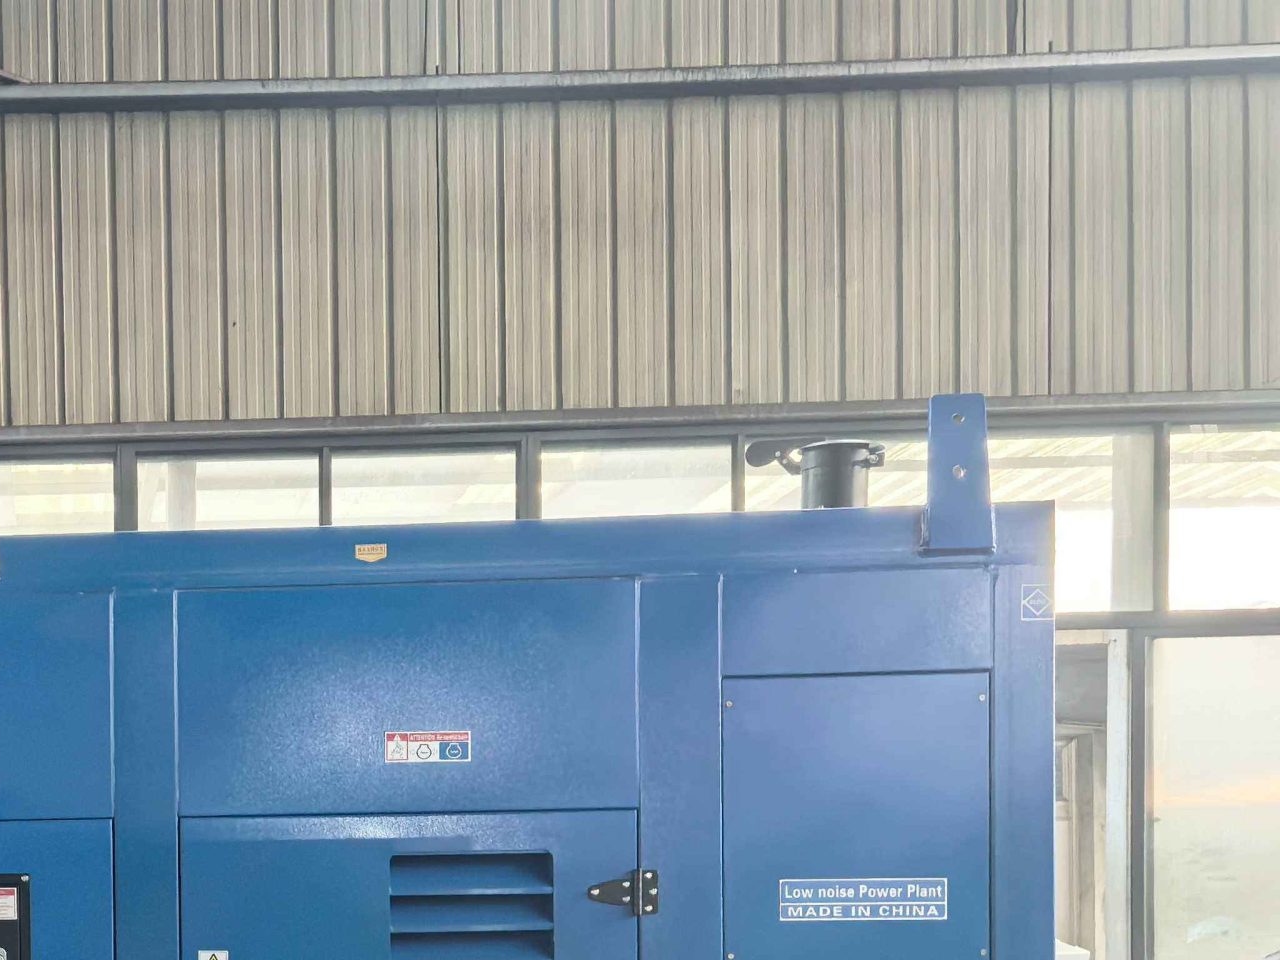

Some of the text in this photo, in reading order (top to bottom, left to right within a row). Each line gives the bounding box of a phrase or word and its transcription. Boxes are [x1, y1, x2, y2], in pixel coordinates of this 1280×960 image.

[785, 883, 942, 899] Low noise Power Plant
[787, 904, 939, 917] MADE IN CHINA
